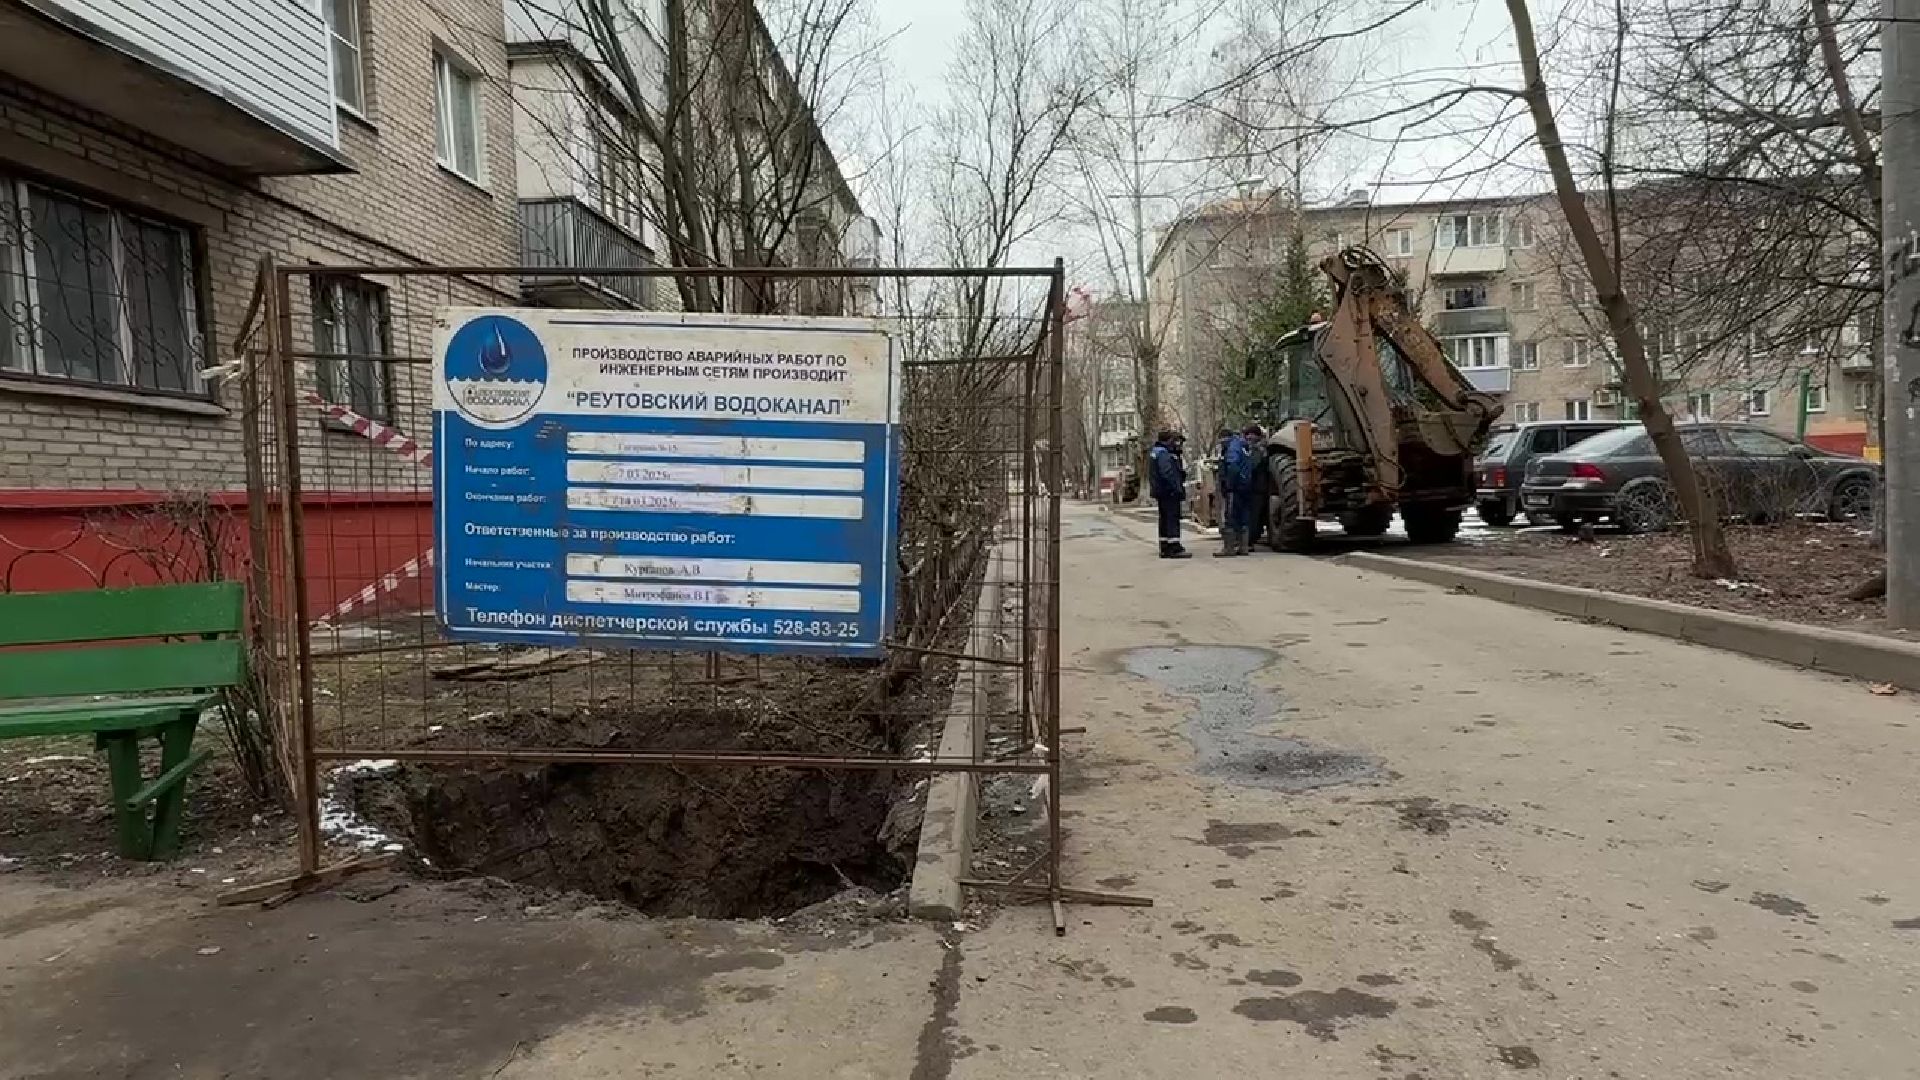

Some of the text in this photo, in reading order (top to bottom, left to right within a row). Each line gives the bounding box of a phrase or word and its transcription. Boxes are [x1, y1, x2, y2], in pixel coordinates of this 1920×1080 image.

[572, 346, 847, 367] ПРОИЗВОДСТВО АВАРИЙНЫХ РАБОТ ПО
[599, 363, 848, 382] ИНЖЕНЕРНЫМ СЕТЯМ ПРОИЗВОДИТ
[465, 437, 515, 450] По адресу:
[465, 465, 530, 476] Начало работ:
[465, 492, 547, 505] Окончание работ:
[464, 522, 736, 545] Ответственные за производство работ:
[466, 606, 859, 637] Телефон диспетчерской службы 528-83-25
